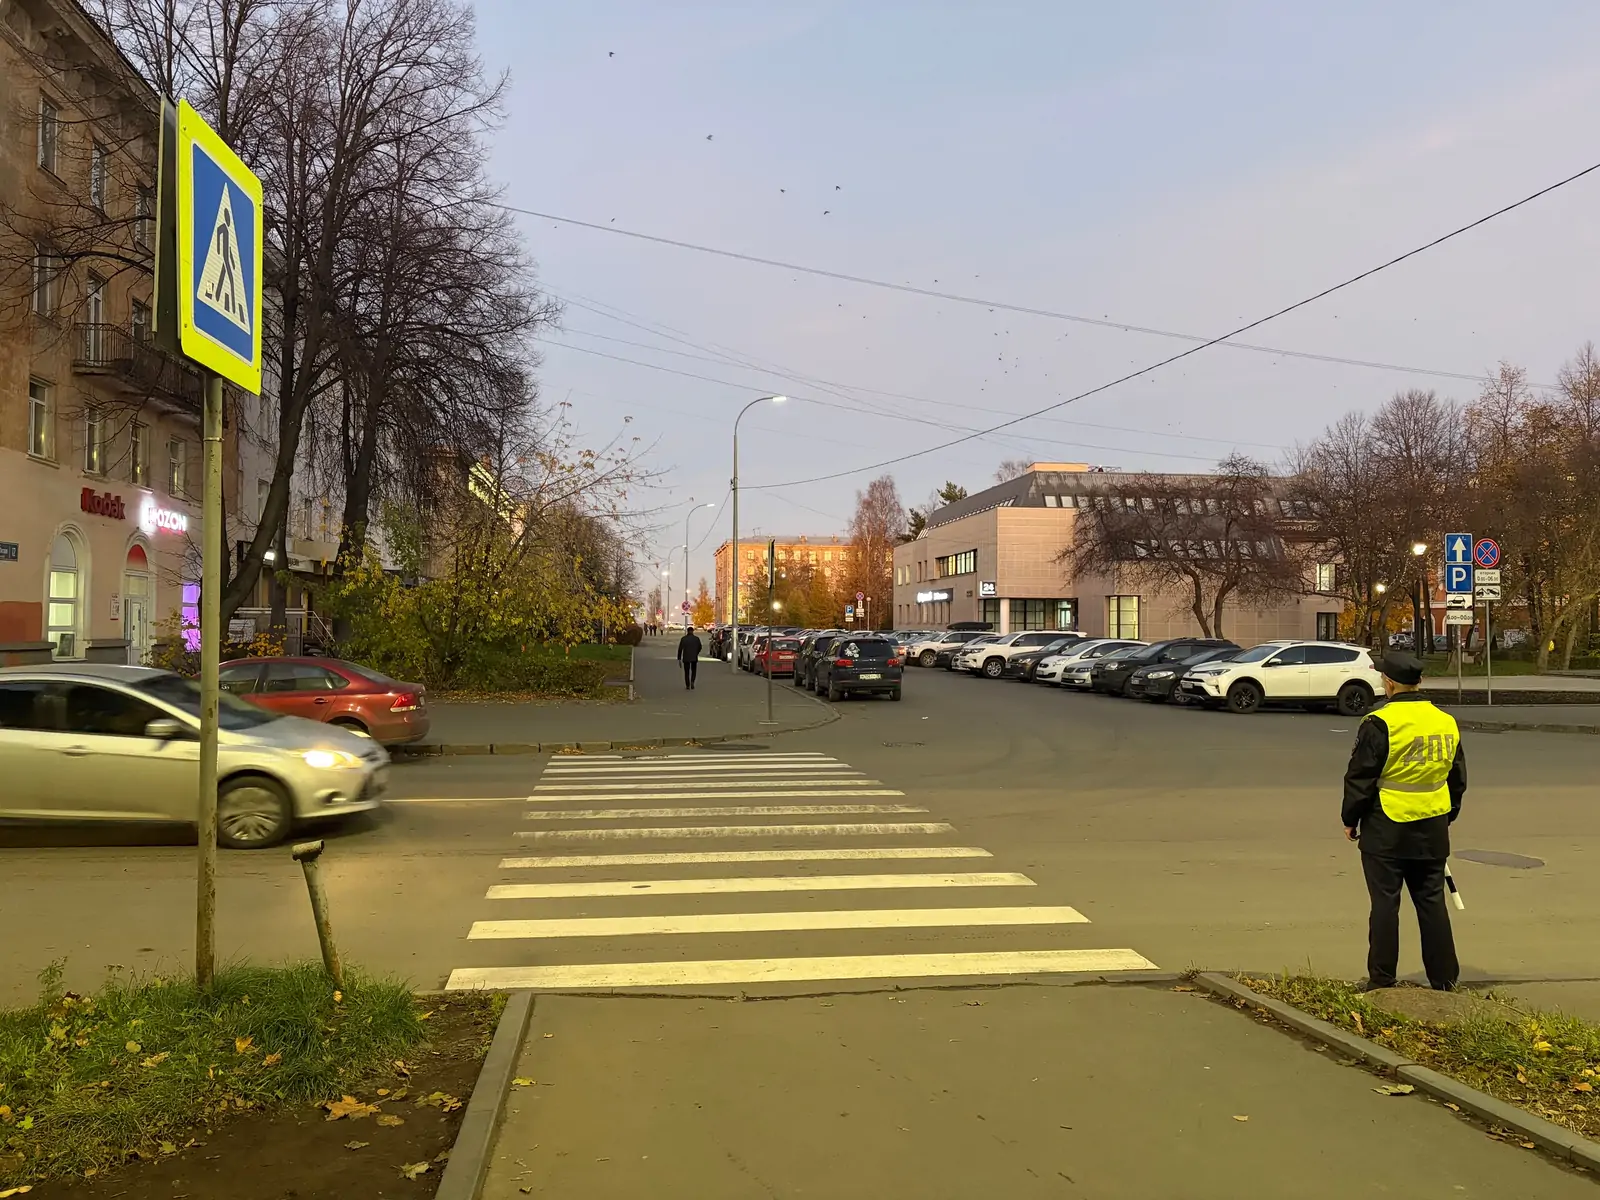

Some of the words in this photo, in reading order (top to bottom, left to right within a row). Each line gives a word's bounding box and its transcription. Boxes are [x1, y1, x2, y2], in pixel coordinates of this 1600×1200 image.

[81, 487, 126, 521] Kodak
[156, 508, 187, 532] OZON
[1452, 567, 1467, 589] P
